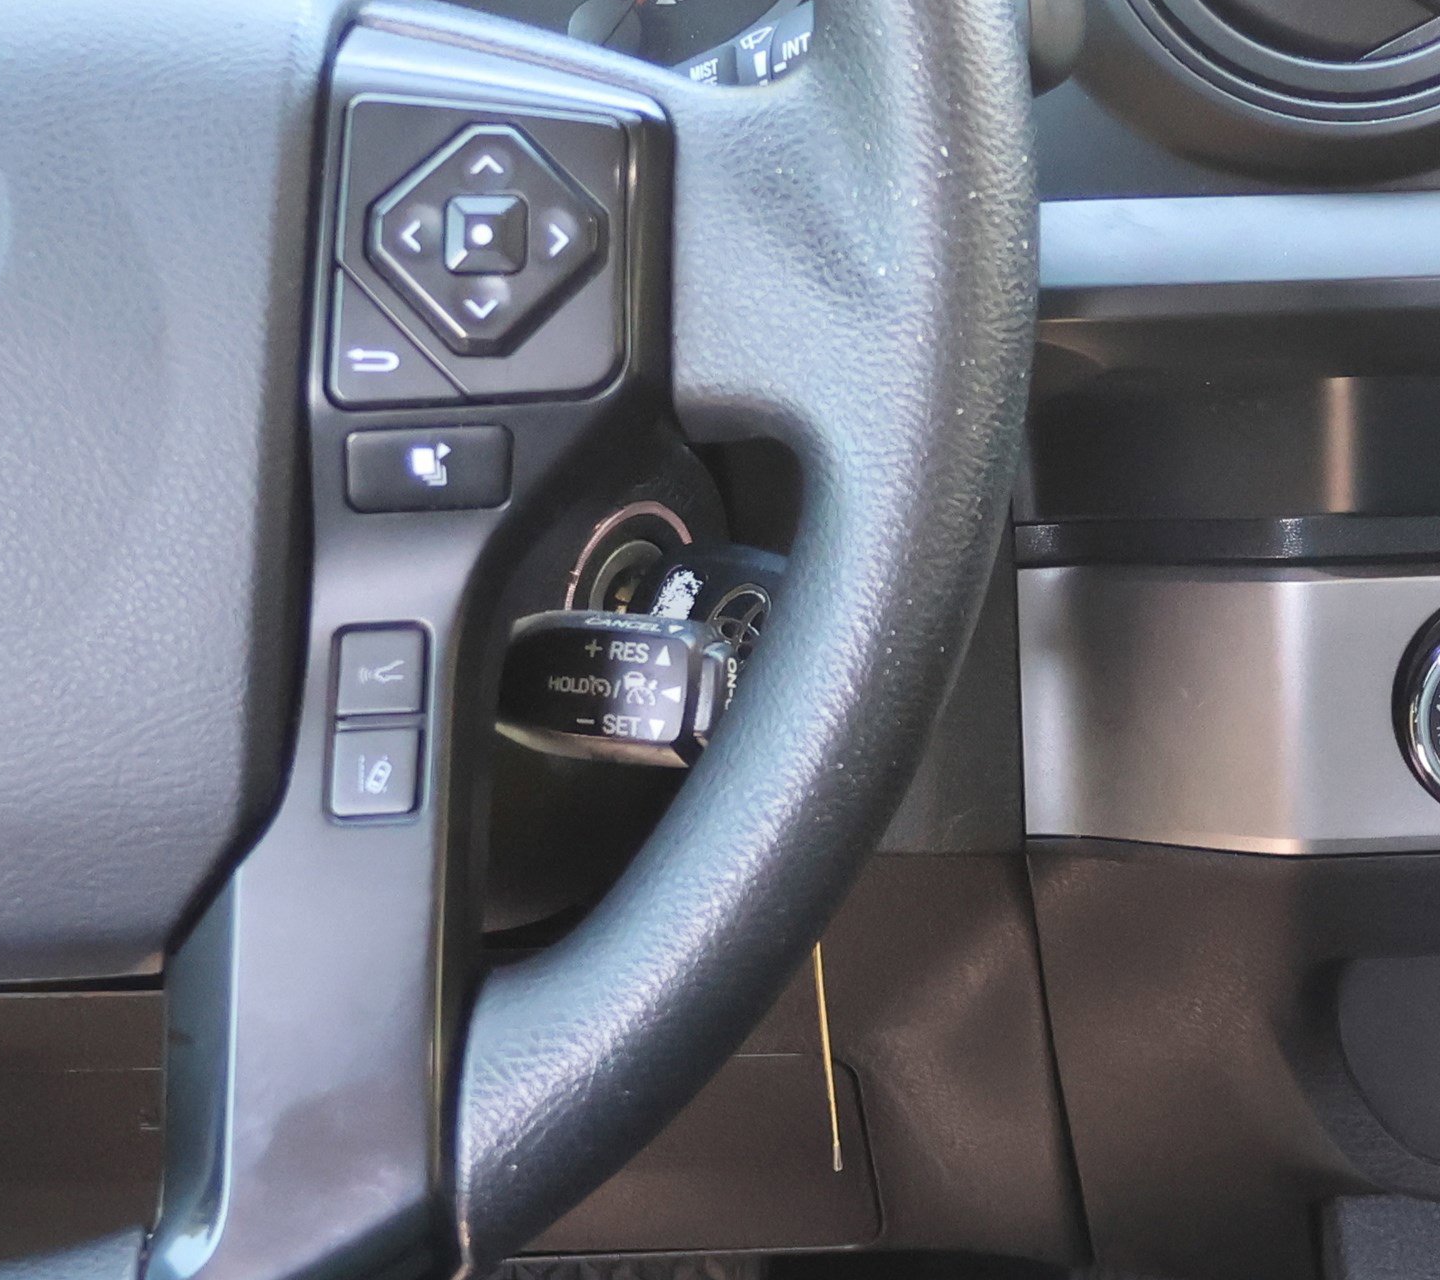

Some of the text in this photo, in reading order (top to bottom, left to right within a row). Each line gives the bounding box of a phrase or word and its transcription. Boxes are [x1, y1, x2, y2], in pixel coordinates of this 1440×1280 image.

[782, 32, 811, 61] INT
[689, 58, 719, 81] MIST
[584, 617, 662, 633] CANCEL
[610, 641, 650, 663] RES
[602, 714, 641, 737] SET
